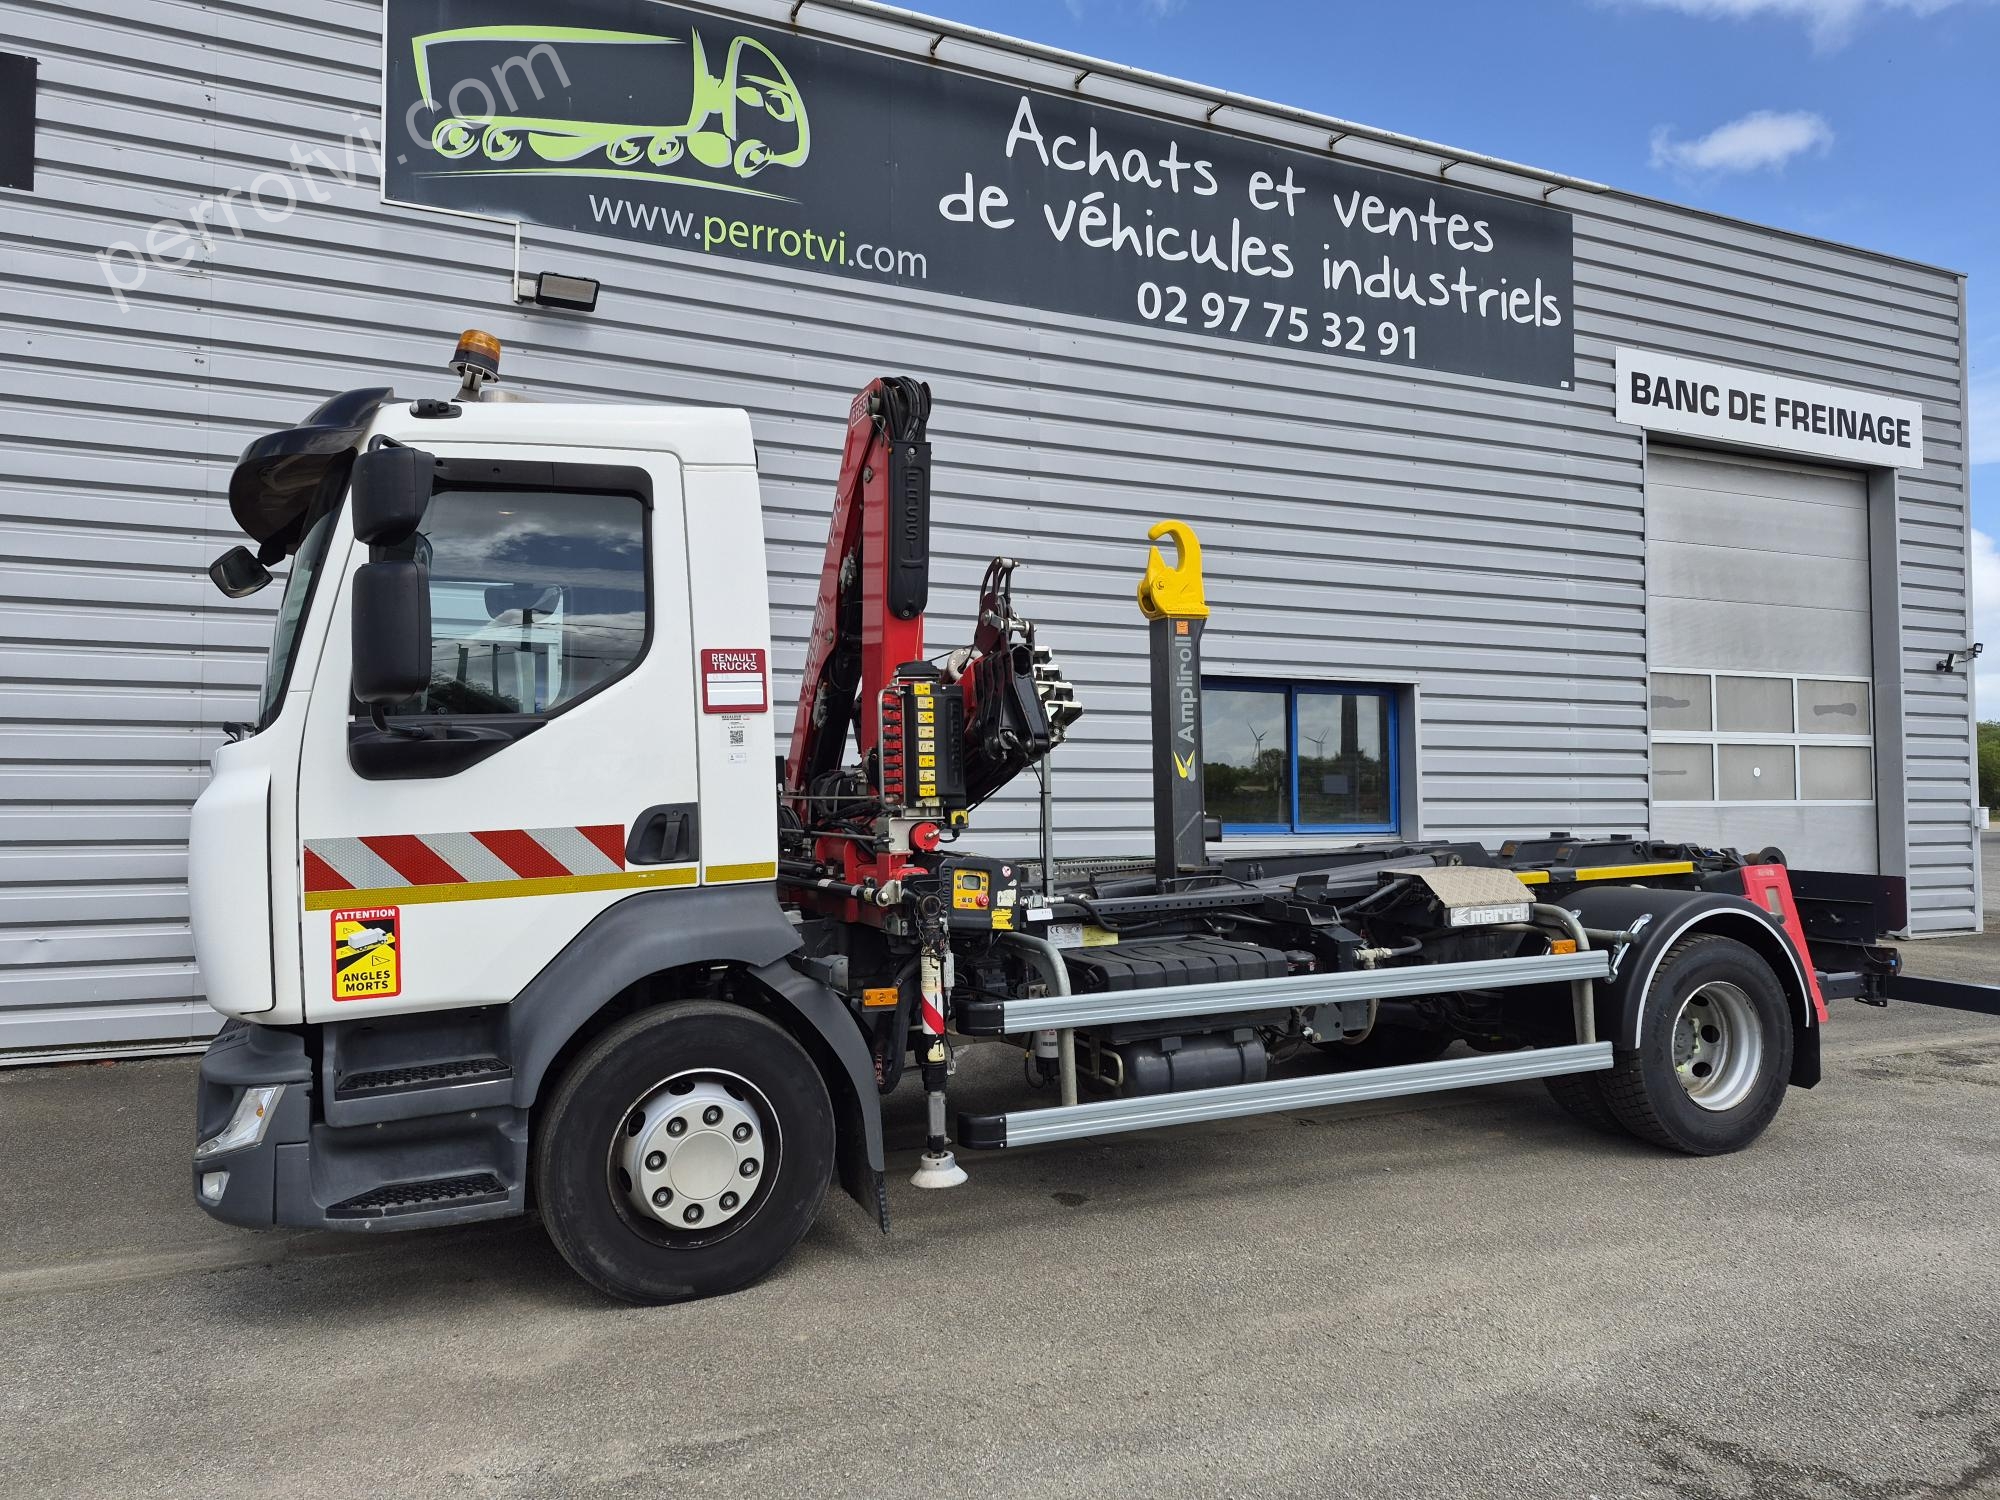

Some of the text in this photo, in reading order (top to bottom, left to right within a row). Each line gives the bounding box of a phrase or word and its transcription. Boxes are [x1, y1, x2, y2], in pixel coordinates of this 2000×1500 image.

[1005, 95, 1494, 254] Achats et ventes
[588, 194, 928, 280] www.perrotvi.com
[939, 172, 1563, 328] de véhicules industriels
[1137, 281, 1417, 360] 02 97 75 32 91
[1630, 371, 1912, 449] BANC DE FREINAGE
[711, 653, 757, 662] RENAULT
[712, 662, 758, 671] TRUCKS
[1175, 635, 1198, 744] Ampliroll
[335, 909, 396, 920] ATTENTION
[343, 970, 391, 982] ANGLES
[346, 981, 389, 992] MORTS
